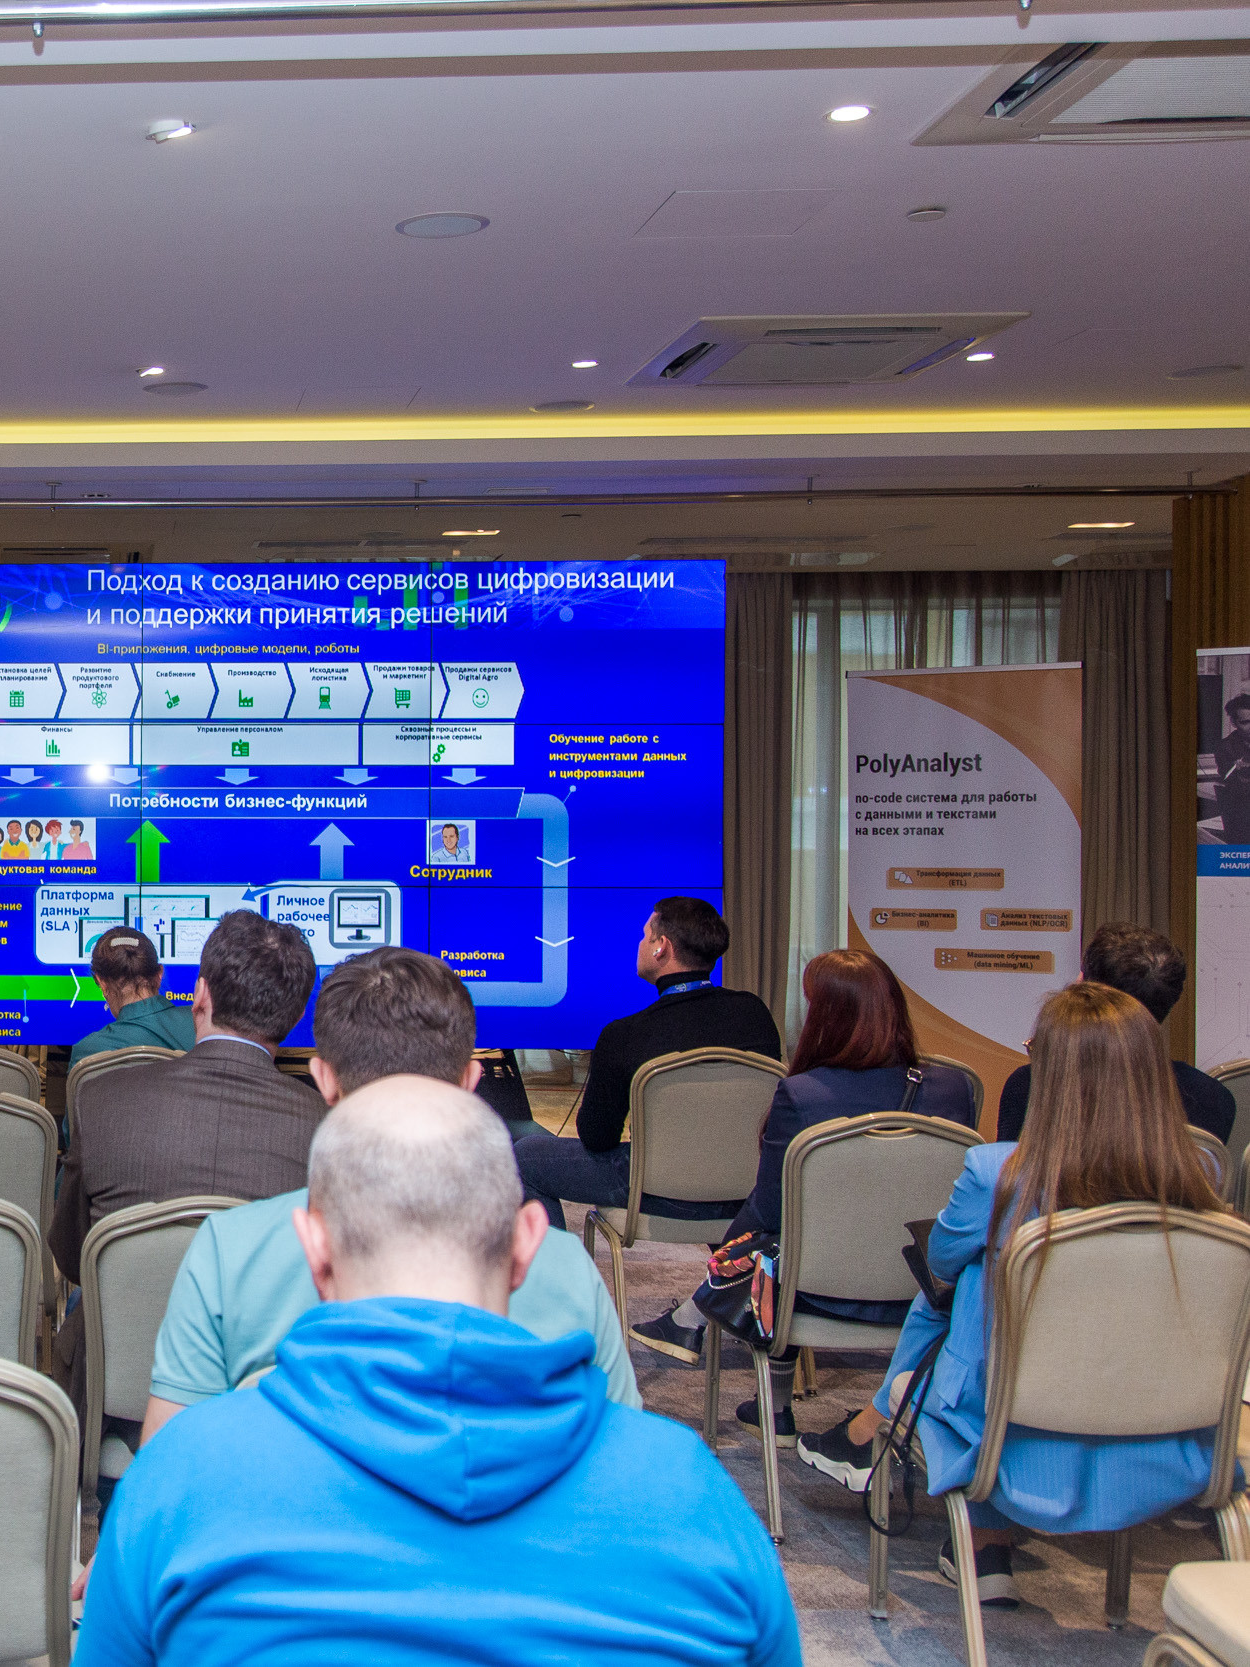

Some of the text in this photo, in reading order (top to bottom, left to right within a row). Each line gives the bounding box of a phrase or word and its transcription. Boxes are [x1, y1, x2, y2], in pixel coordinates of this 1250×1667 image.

[87, 567, 675, 595] Подход к созданию сервисов цифровизации
[87, 601, 508, 629] и поддержки принятия решений
[195, 643, 259, 656] цифровые
[262, 645, 310, 656] модели,
[315, 643, 360, 655] роботы
[30, 666, 52, 675] целей
[80, 666, 112, 674] Развитие
[156, 670, 196, 678] Снабжение
[227, 669, 277, 677] Производство
[309, 666, 349, 675] Исходящая
[373, 665, 435, 673] Продажи товаров
[444, 666, 478, 674] Продажи
[458, 673, 499, 682] Digital Agro
[79, 682, 113, 690] портфеля
[40, 725, 73, 733] Финансы
[197, 726, 239, 734] Управление
[400, 725, 434, 733] Сквозные
[435, 726, 470, 734] процессы
[549, 733, 660, 746] Обучение работе с
[549, 752, 687, 763] инструментами данных
[855, 752, 982, 777] PolyAnalyst
[549, 768, 645, 781] и цифровизации
[109, 793, 367, 812] Потребности бизнес-функций
[855, 791, 1037, 805] no-code система для работы
[855, 809, 997, 822] с данными и текстами
[855, 826, 944, 836] на всех этапах
[49, 865, 97, 876] команда
[409, 865, 493, 880] Сотрудник
[948, 879, 967, 887] (ETL)
[40, 889, 114, 904] Платформа
[276, 895, 325, 906] Личное
[40, 906, 90, 918] данных
[277, 911, 330, 922] рабочее
[40, 920, 69, 933] (SLA
[916, 920, 930, 928] (BI)
[440, 950, 505, 962] Разработка
[974, 960, 992, 969] (data
